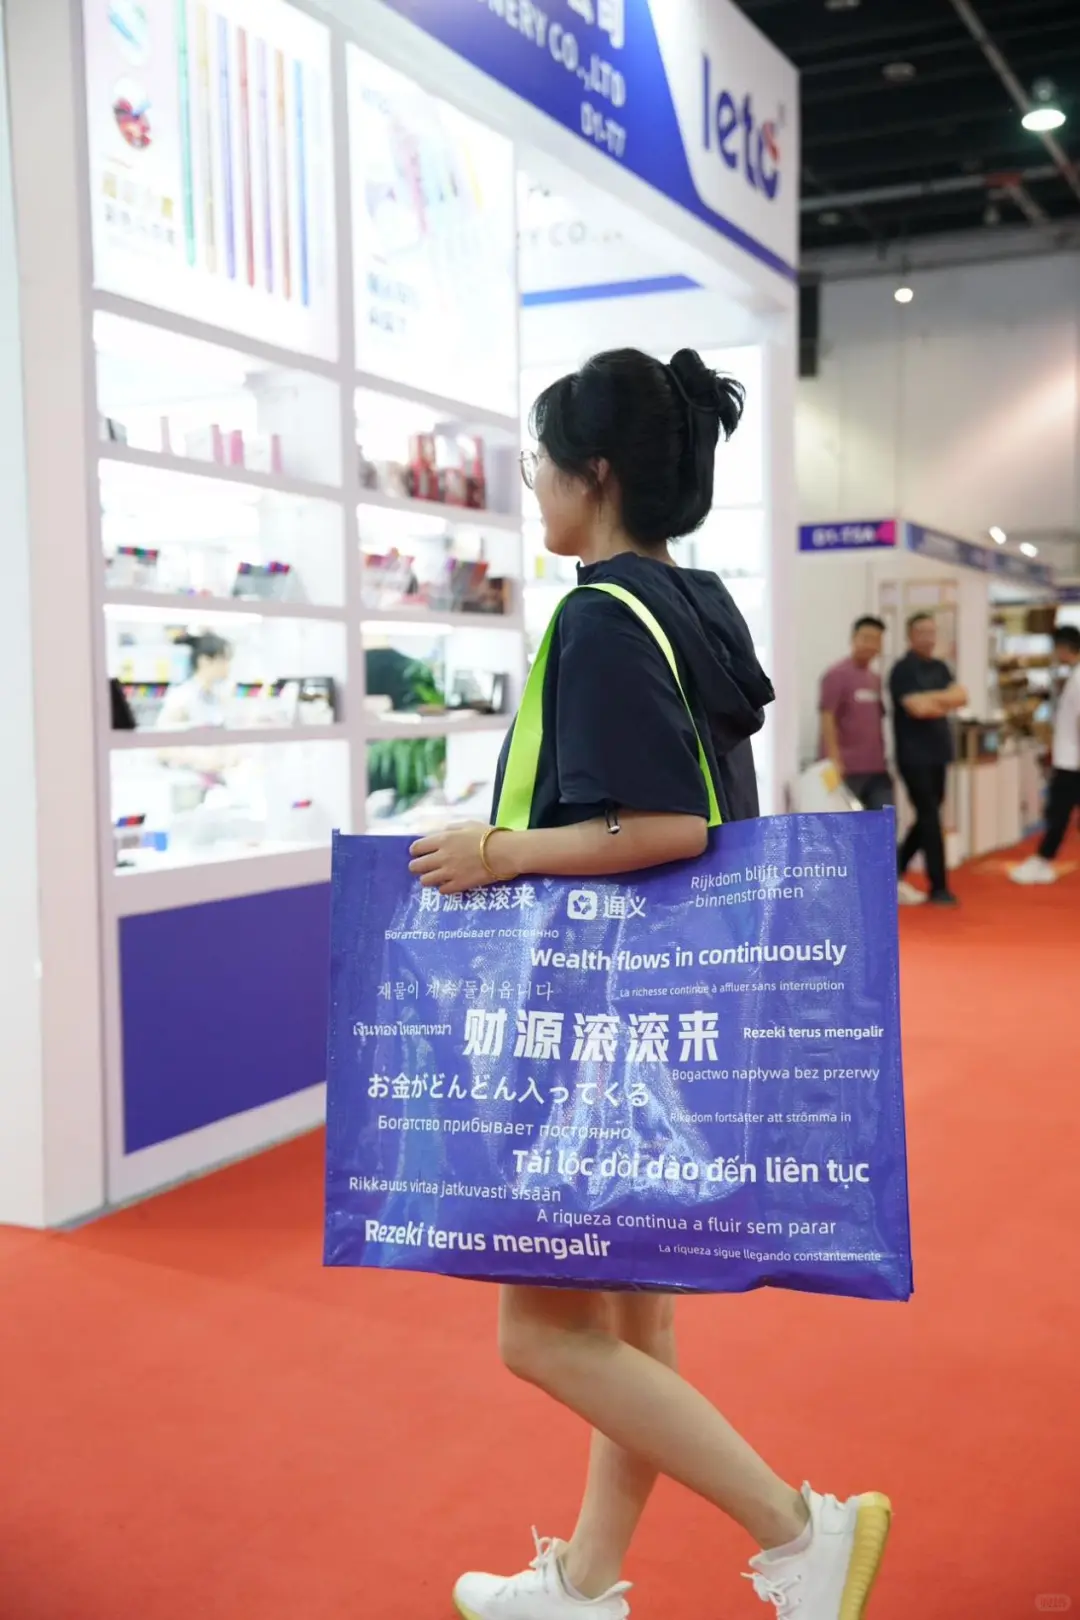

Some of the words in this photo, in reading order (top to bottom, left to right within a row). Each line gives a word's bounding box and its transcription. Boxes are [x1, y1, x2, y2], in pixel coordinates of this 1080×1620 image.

[691, 869, 742, 892] Rijkdom
[745, 863, 779, 882] blijft
[783, 864, 848, 879] continu
[602, 896, 647, 920] 通义
[384, 928, 436, 941] Богатство
[437, 928, 496, 942] прибывает
[530, 948, 611, 972] Wealth
[617, 949, 671, 973] flows
[675, 946, 694, 968] in
[698, 939, 848, 967] continuously
[376, 980, 419, 1001] 재물이
[462, 980, 555, 1001] 들어옵니다
[632, 985, 668, 997] richesse
[670, 984, 709, 996] continue
[711, 982, 718, 994] à
[719, 981, 750, 994] affluer
[752, 981, 777, 993] sans
[779, 979, 845, 994] interruption
[463, 1007, 720, 1063] 财源滚滚来
[743, 1026, 786, 1040] Rezeki
[788, 1026, 822, 1039] terus
[825, 1024, 885, 1041] mengalir
[672, 1069, 729, 1083] Bogactwo
[732, 1067, 790, 1082] napływa
[794, 1067, 819, 1079] bez
[823, 1067, 881, 1082] przerwy
[367, 1071, 650, 1108] お金がどんどん入ってくる
[378, 1115, 440, 1132] Богатство
[443, 1117, 535, 1136] прибывает
[539, 1122, 633, 1140] постоянно
[715, 1111, 764, 1124] fortsätter
[767, 1112, 784, 1124] att
[786, 1111, 838, 1124] strömma
[840, 1110, 852, 1123] in
[512, 1149, 551, 1174] Tài
[646, 1154, 699, 1181] dào
[706, 1154, 756, 1184] đến
[766, 1155, 819, 1184] liên
[828, 1158, 870, 1190] tục
[349, 1176, 408, 1193] Rikkauus
[409, 1178, 439, 1195] virtaa
[440, 1180, 508, 1200] jatkuvasti
[511, 1185, 562, 1203] sisään
[536, 1208, 549, 1224] A
[552, 1209, 612, 1228] riqueza
[616, 1213, 688, 1231] continua
[693, 1218, 704, 1231] a
[708, 1216, 742, 1234] fluir
[747, 1221, 783, 1235] sem
[788, 1220, 837, 1239] parar
[364, 1219, 424, 1247] Rezeki
[427, 1225, 487, 1251] terus
[493, 1233, 611, 1260] mengalir
[658, 1243, 671, 1254] La
[673, 1244, 712, 1258] riqueza
[714, 1247, 742, 1260] sigue
[744, 1248, 792, 1263] llegando
[794, 1250, 882, 1263] constantemente
